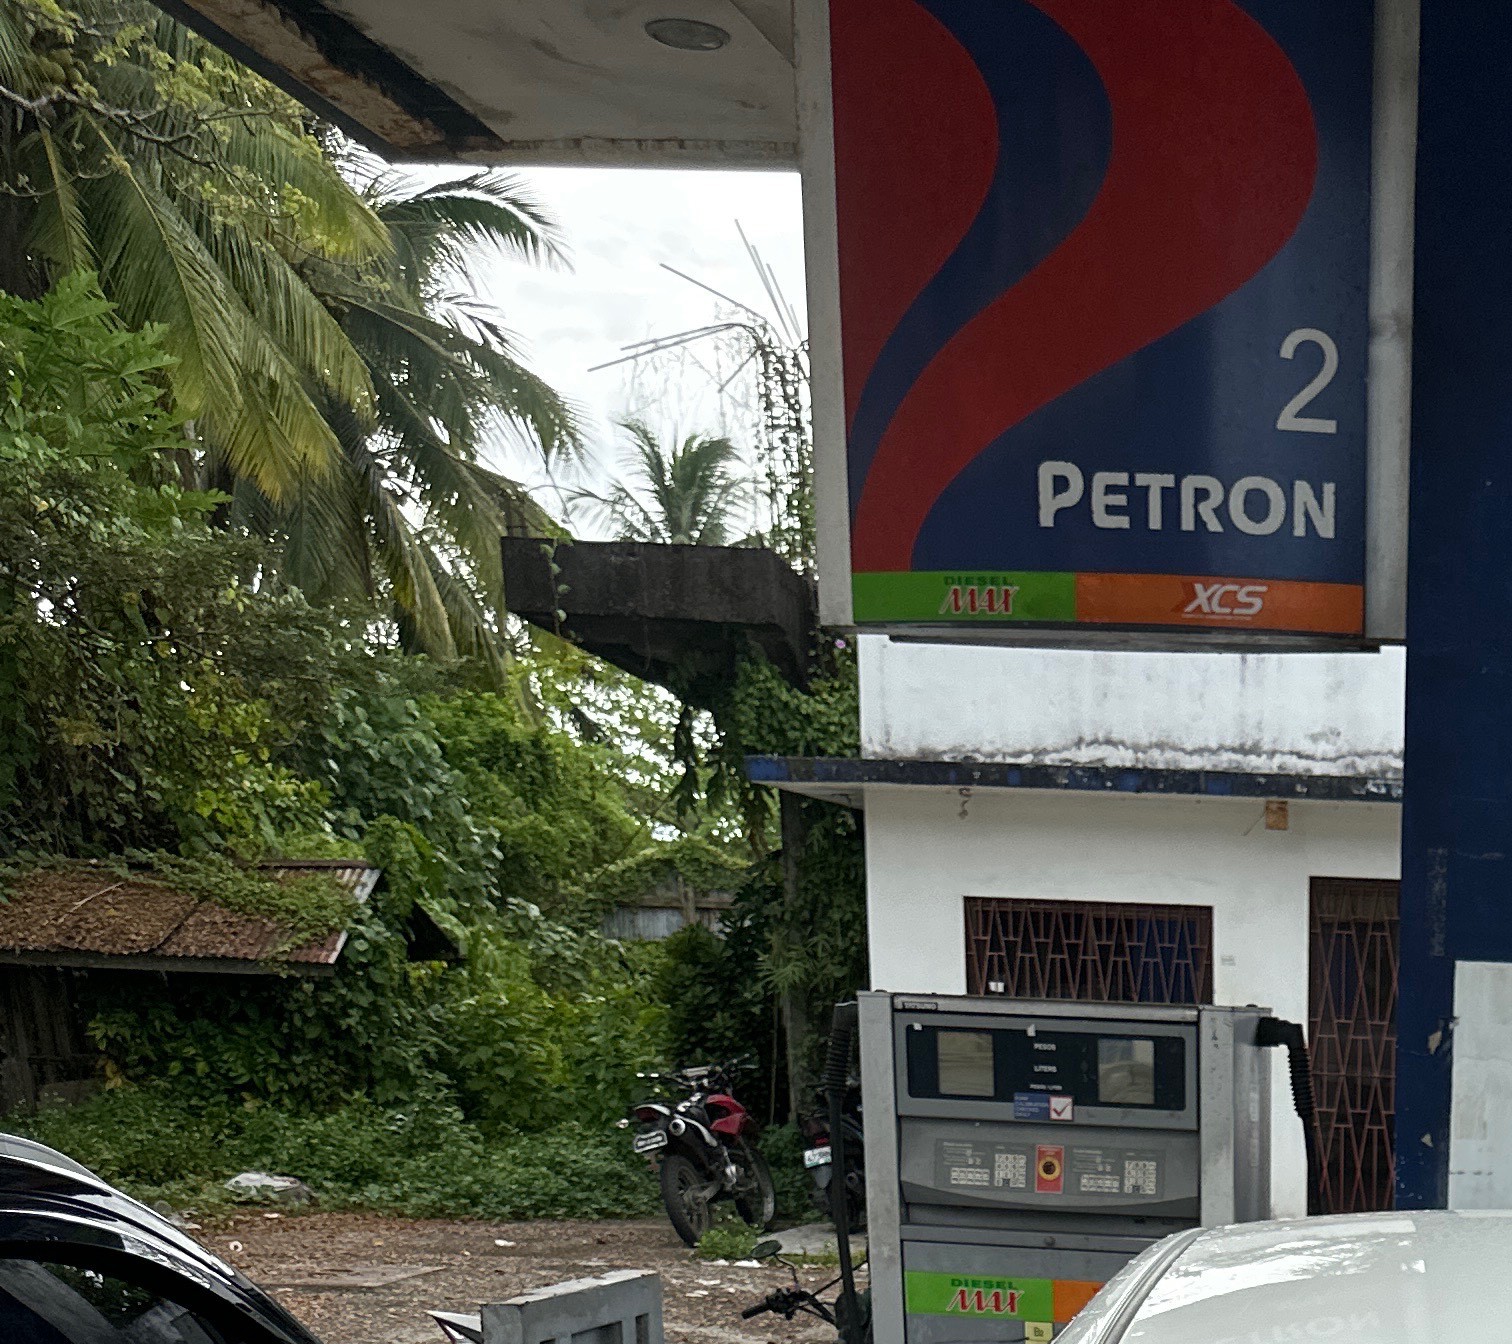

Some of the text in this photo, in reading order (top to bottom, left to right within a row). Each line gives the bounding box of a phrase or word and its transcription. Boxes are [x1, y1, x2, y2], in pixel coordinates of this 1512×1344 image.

[1276, 328, 1340, 434] 2
[1037, 459, 1337, 539] PETRON
[938, 586, 1019, 614] MAX
[1183, 583, 1268, 614] XCS
[951, 1278, 1018, 1289] DIESEL
[946, 1287, 1024, 1315] MAX
